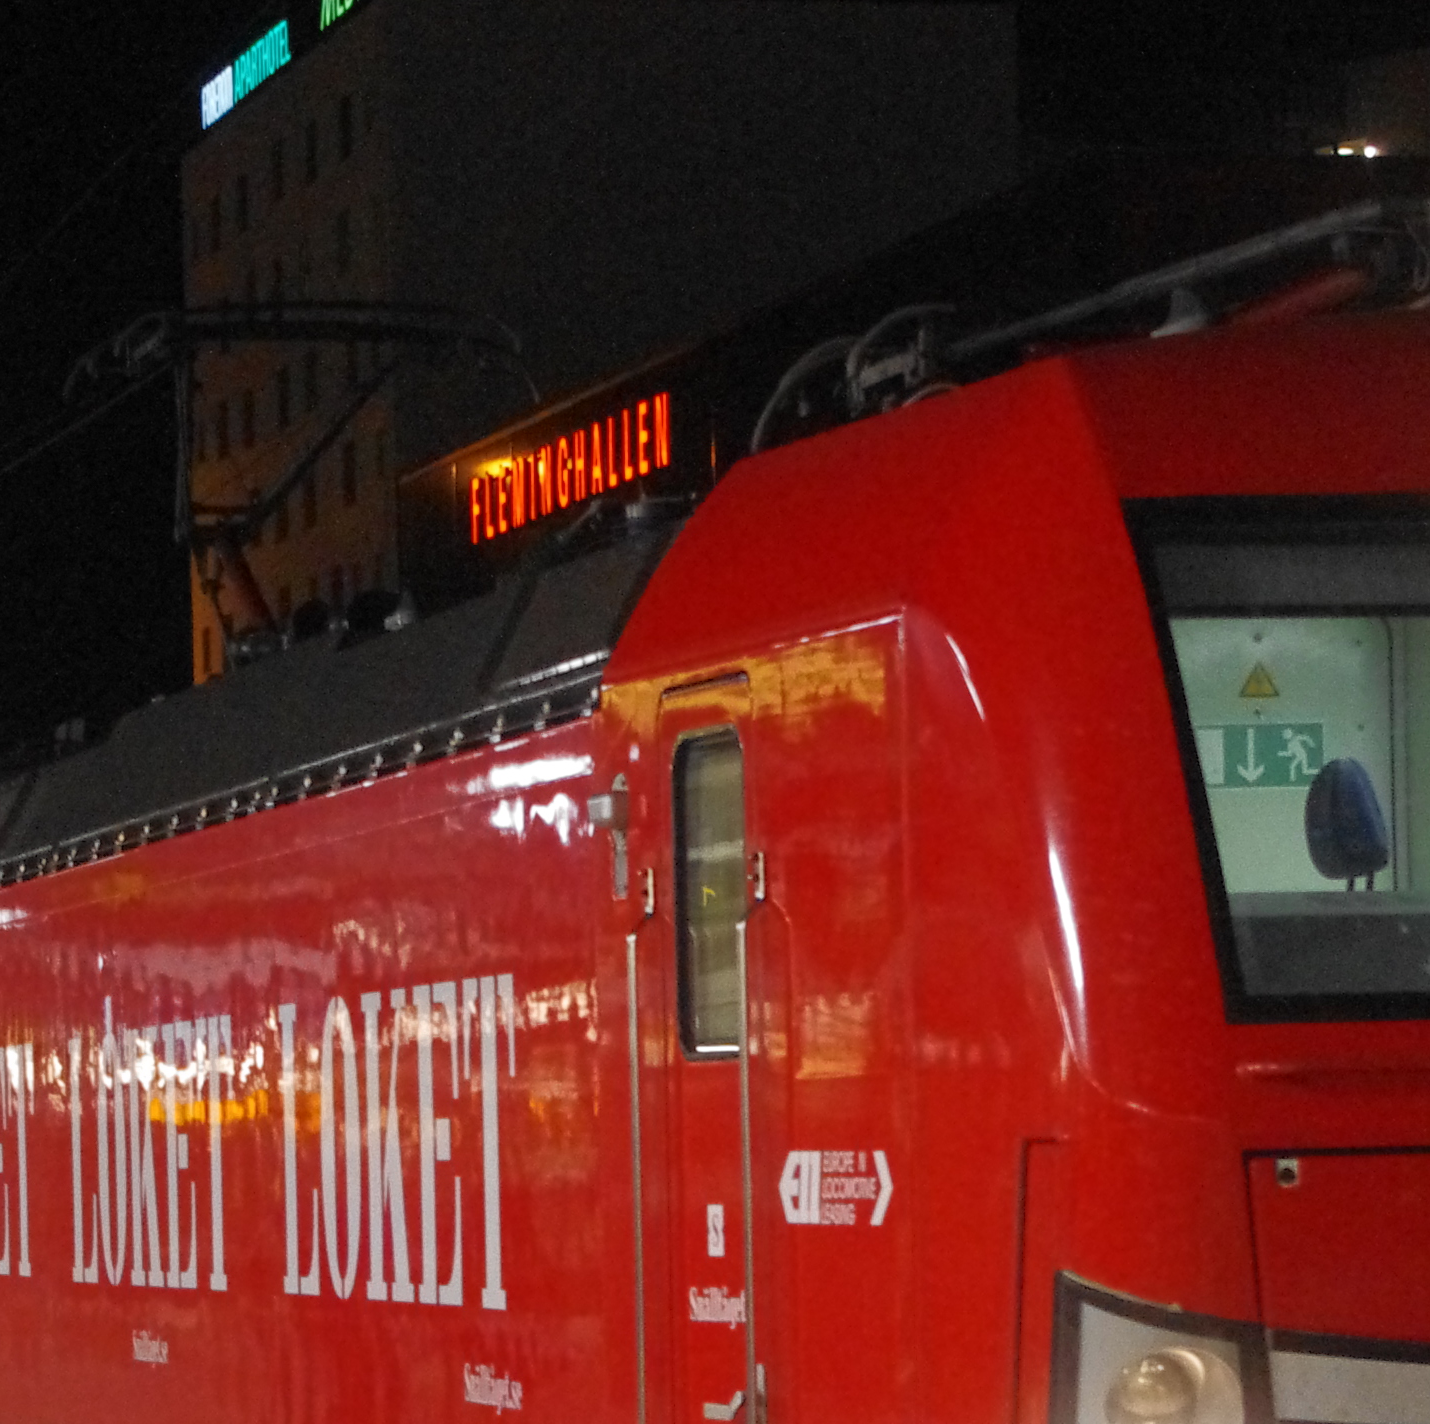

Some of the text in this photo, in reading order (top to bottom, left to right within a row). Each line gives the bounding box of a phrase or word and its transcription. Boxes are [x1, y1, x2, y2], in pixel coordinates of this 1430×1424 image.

[233, 19, 291, 104] APARTHOTEL
[470, 391, 670, 545] FLEMINGHALLEN
[69, 1012, 232, 1292] LOKET
[278, 973, 516, 1310] LOKET
[821, 1177, 877, 1199] LOCOMOTIVE
